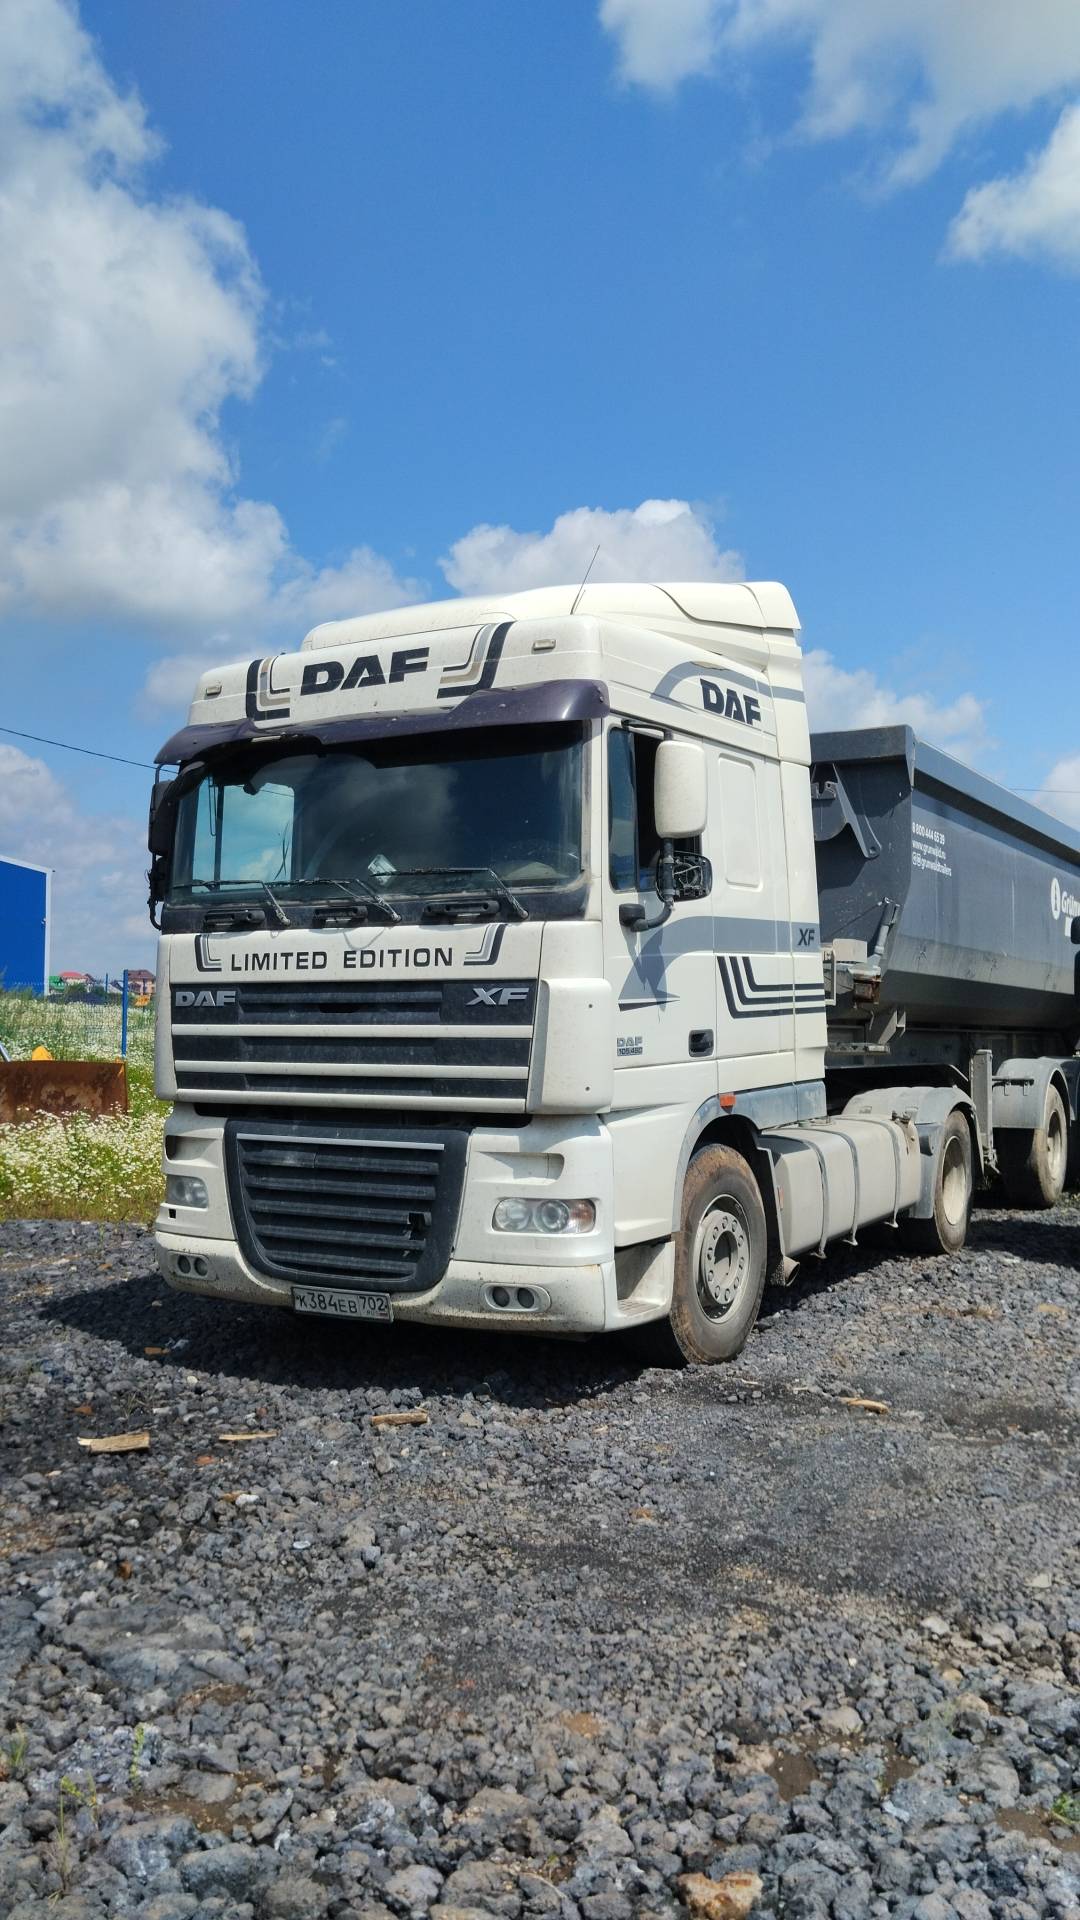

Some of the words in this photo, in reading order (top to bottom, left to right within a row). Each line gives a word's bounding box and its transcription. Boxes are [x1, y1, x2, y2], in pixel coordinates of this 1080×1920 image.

[301, 647, 430, 696] DAF
[700, 678, 761, 726] DAF
[798, 928, 815, 946] XF
[231, 951, 328, 972] LIMITED
[343, 947, 453, 968] EDITION
[175, 990, 237, 1007] DAF
[465, 987, 530, 1006] XF
[617, 1036, 643, 1047] DAF
[359, 1296, 385, 1311] 702
